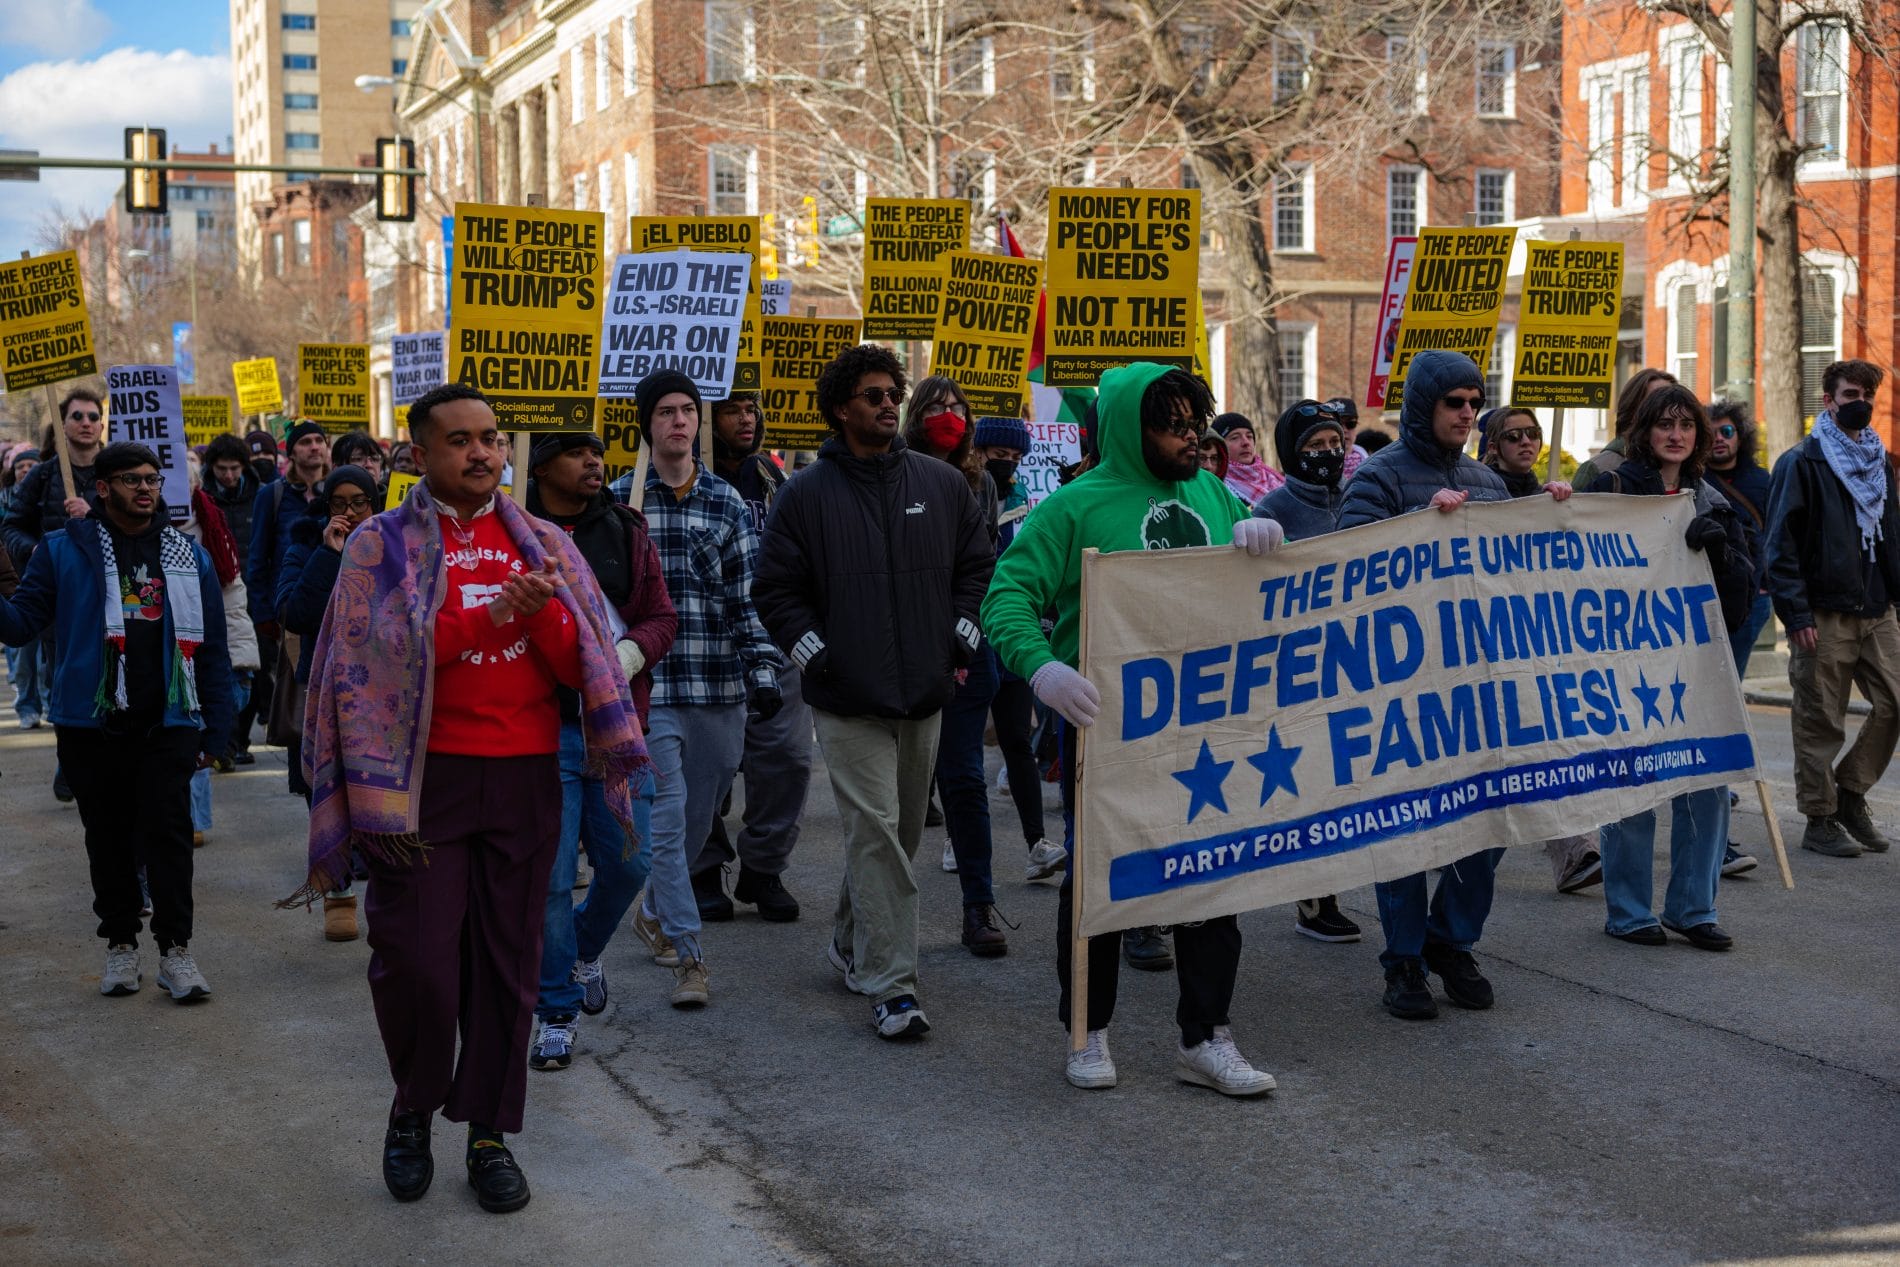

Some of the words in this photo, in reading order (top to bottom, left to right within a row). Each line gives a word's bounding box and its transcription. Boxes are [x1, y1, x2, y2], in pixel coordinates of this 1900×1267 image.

[871, 206, 901, 222] THE
[906, 207, 963, 223] PEOPLE
[1059, 196, 1141, 220] MONEY
[1147, 197, 1190, 220] FOR
[463, 216, 508, 243] THE
[515, 219, 596, 249] PEOPLE
[679, 224, 751, 244] PUEBLO
[872, 224, 906, 238] WILL
[910, 225, 963, 240] DEFEAT
[1058, 222, 1190, 251] PEOPLE'S
[1423, 235, 1453, 256] THE
[1455, 235, 1510, 256] PEOPLE
[463, 245, 515, 270] WILL
[521, 248, 596, 275] DEFEAT
[1077, 252, 1169, 281] NEEDS
[1532, 249, 1560, 268] THE
[1564, 250, 1619, 271] PEOPLE
[0, 269, 19, 285] HE
[22, 258, 74, 281] PEOPLE
[617, 262, 679, 292] END
[686, 262, 744, 294] THE
[951, 257, 1038, 287] WORKERS
[1415, 258, 1504, 292] UNITED
[1530, 270, 1563, 288] WILL
[1568, 271, 1618, 290] DEFEAT
[30, 274, 76, 294] DEFEAT
[461, 272, 594, 310] TRUMP'S
[761, 283, 784, 295] AEL:
[871, 276, 942, 291] BILLIONAI
[946, 280, 1000, 301] SHOULD
[1002, 287, 1035, 305] HAVE
[0, 289, 80, 321] TRUMP'S
[613, 295, 738, 317] U.S.-ISRAELI
[868, 293, 939, 314] AGEND
[1056, 296, 1119, 327] NOT
[1127, 297, 1186, 328] THE
[1411, 293, 1445, 312] WILL
[1448, 292, 1498, 313] DEFEND
[1527, 290, 1616, 317] TRUMP'S
[942, 298, 1031, 335] POWER
[3, 321, 84, 348] EXTREME-RIGHT
[609, 324, 678, 350] WAR
[686, 325, 730, 353] ON
[763, 321, 821, 339] MONEY
[824, 324, 854, 340] FOR
[1054, 330, 1094, 347] WAR
[1100, 330, 1186, 347] MACHINE!
[1402, 327, 1493, 349] IMMIGRANT
[7, 334, 87, 368] AGENDA!
[303, 347, 341, 358] MONEY
[345, 347, 365, 358] FOR
[395, 340, 418, 355] END
[422, 338, 441, 351] THE
[461, 329, 593, 356] BILLIONAIRE
[1523, 334, 1612, 350] EXTREME-RIGHT
[303, 359, 366, 373] PEOPLE'S
[936, 341, 982, 368] NOT
[987, 345, 1024, 372] THE
[1053, 360, 1075, 371] Party
[1076, 360, 1089, 369] for
[1090, 360, 1132, 369] Socialism
[1519, 351, 1609, 377] AGENDA!
[396, 372, 422, 385] WAR
[425, 368, 440, 380] ON
[458, 356, 589, 391] AGENDA!
[601, 354, 726, 382] LEBANON
[772, 361, 825, 379] NEED
[934, 368, 1020, 388] BILLIONAIRES!
[1053, 371, 1095, 380] Liberation
[110, 370, 167, 389] SRAEL:
[312, 373, 356, 386] NEEDS
[109, 390, 161, 415] NDS
[304, 392, 333, 407] NOT
[337, 393, 366, 407] THE
[495, 402, 538, 412] Socialism
[540, 403, 555, 412] and
[762, 389, 800, 410] NOT
[183, 417, 228, 428] POWER
[304, 408, 323, 417] WAR
[325, 408, 366, 417] MACHINE!
[513, 415, 564, 426] PSLWeb.org
[603, 407, 641, 424] SHO
[764, 411, 780, 423] AR
[784, 412, 827, 424] MACHI
[124, 416, 169, 441] THE
[1025, 423, 1077, 444] RIFFS
[1032, 443, 1062, 454] ON'T
[1016, 468, 1057, 494] RIC
[169, 507, 186, 515] ATION
[445, 547, 508, 567] CIALISM
[511, 561, 523, 572] &
[1259, 562, 1338, 621] THE
[1343, 537, 1474, 603] PEOPLE
[1479, 530, 1585, 575] UNITED
[1586, 532, 1649, 568] WILL
[1121, 605, 1425, 742] DEFEND
[1438, 584, 1717, 669] IMMIGRANT
[1327, 668, 1630, 786] FAMILIES!
[1164, 841, 1247, 880] PARTY
[1253, 831, 1301, 857] FOR
[1308, 800, 1431, 845] SOCIALISM
[1439, 784, 1479, 813] AND
